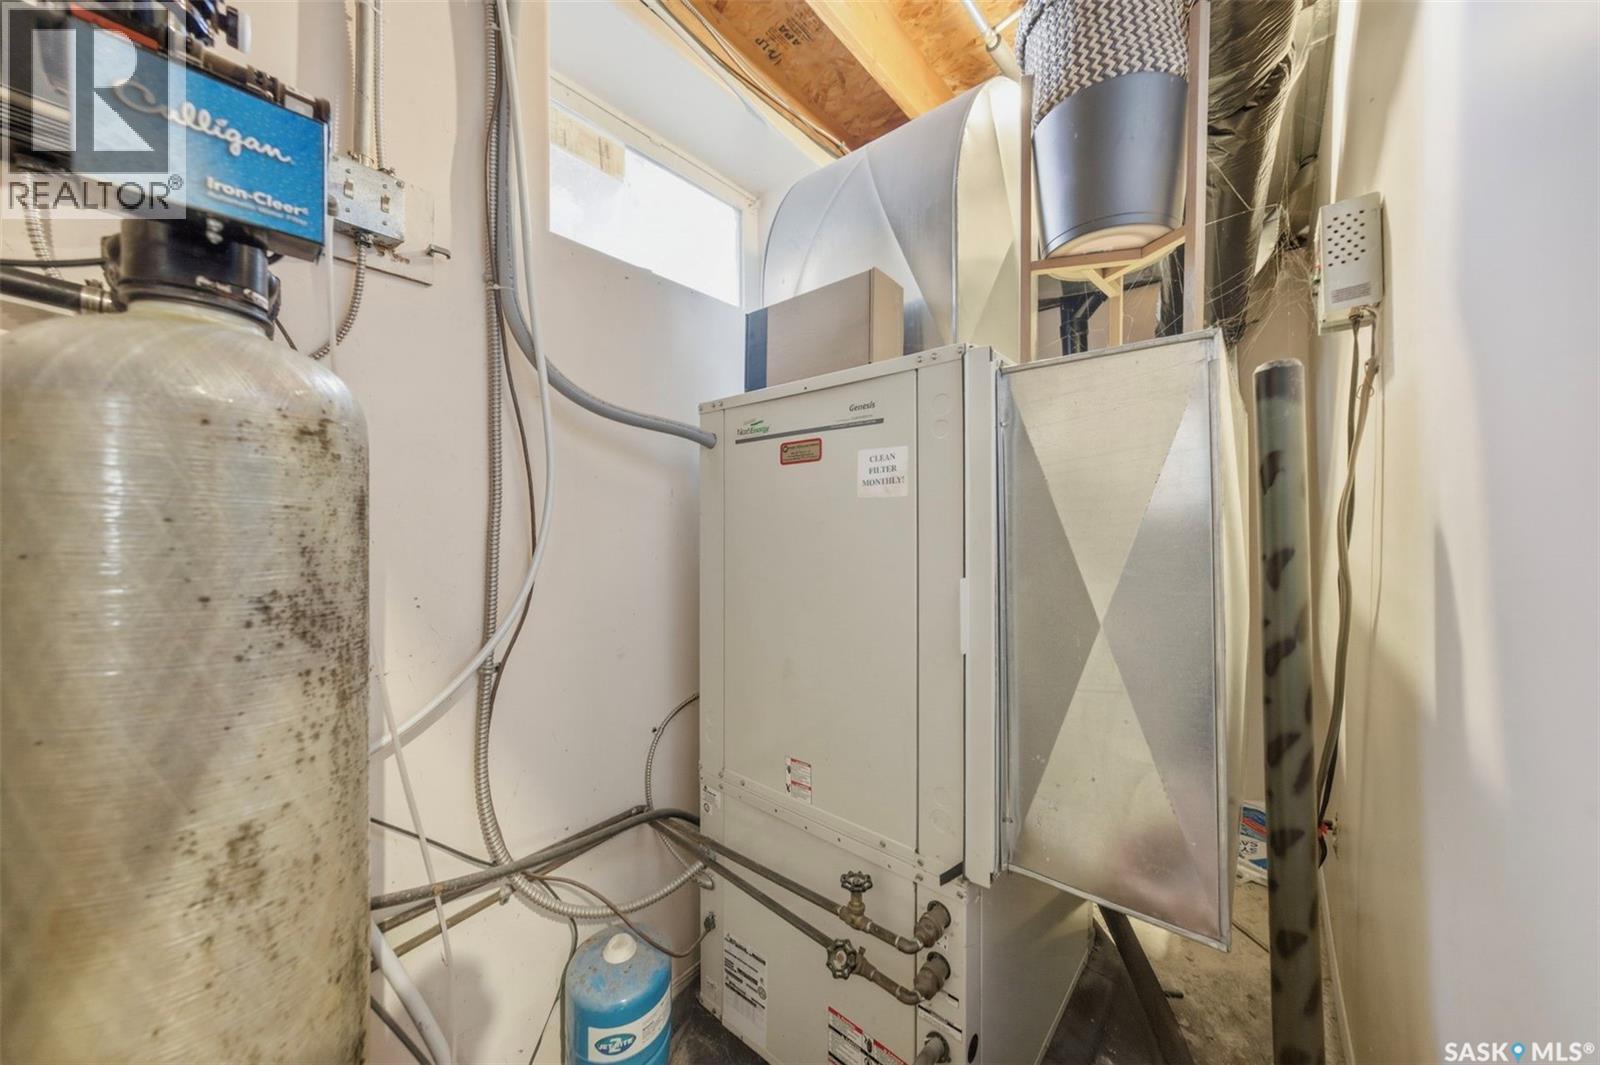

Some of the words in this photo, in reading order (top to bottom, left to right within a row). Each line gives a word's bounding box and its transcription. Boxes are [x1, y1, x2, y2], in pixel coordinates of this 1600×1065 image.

[113, 79, 294, 165] Culligan
[848, 401, 876, 412] Genesis
[868, 453, 896, 463] CLEAN
[868, 464, 897, 475] FILTER
[862, 475, 905, 487] MONTHLY!
